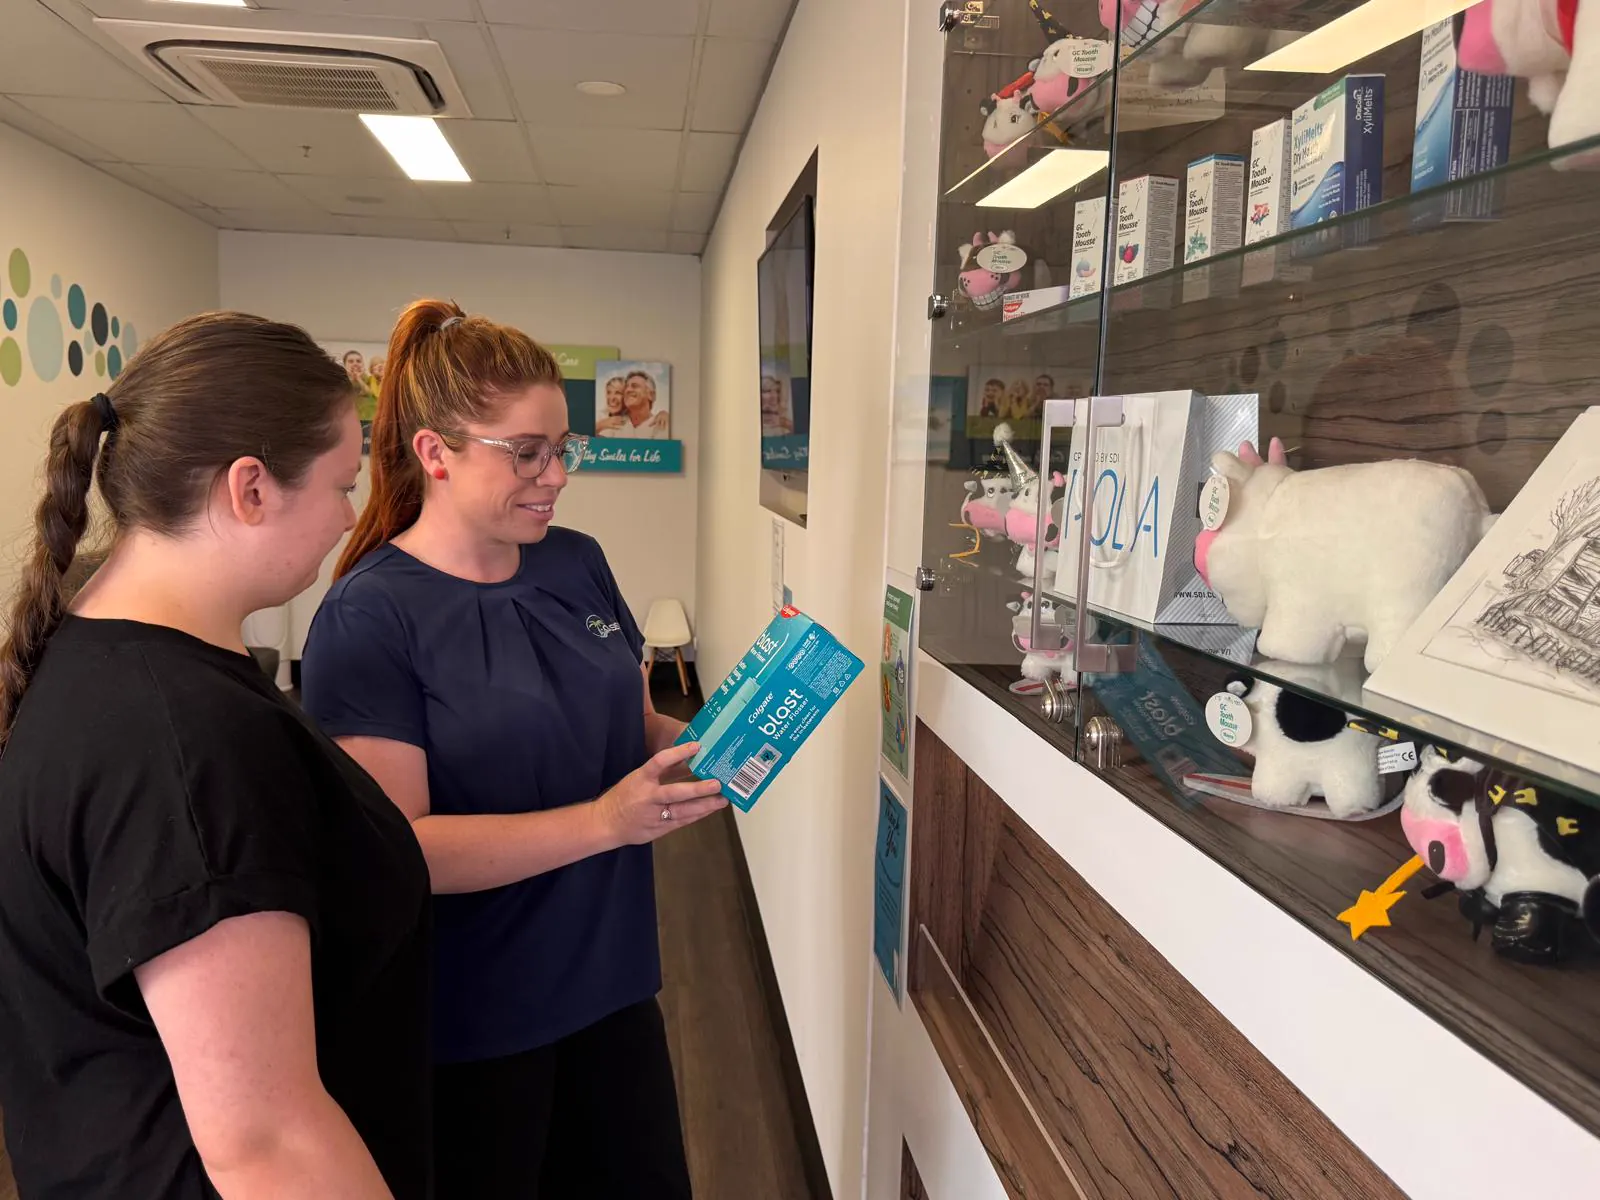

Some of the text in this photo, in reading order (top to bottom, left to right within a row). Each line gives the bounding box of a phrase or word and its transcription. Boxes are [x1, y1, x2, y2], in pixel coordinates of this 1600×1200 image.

[1363, 88, 1375, 134] XyliMelts
[1252, 158, 1260, 168] GC
[1251, 166, 1267, 179] Tooth
[1250, 176, 1271, 189] Mousse
[1189, 190, 1197, 199] GC
[1189, 196, 1204, 208] Tooth
[1120, 206, 1127, 214] GC
[1188, 206, 1208, 217] Mousse
[1120, 212, 1134, 222] Tooth
[1075, 223, 1084, 231] GC
[1119, 221, 1138, 230] Mousse
[1075, 230, 1091, 239] Tooth
[1074, 238, 1096, 247] Mousse
[598, 448, 627, 462] Smiles
[629, 449, 641, 462] for
[644, 449, 661, 462] Life
[1100, 453, 1108, 462] BY
[1109, 453, 1120, 463] SDI
[748, 692, 774, 724] Colgate
[758, 688, 803, 735] blast
[1220, 703, 1227, 711] GC
[773, 698, 809, 740] Water Flosser
[1220, 710, 1233, 721] Tooth
[1401, 751, 1415, 762] CE
